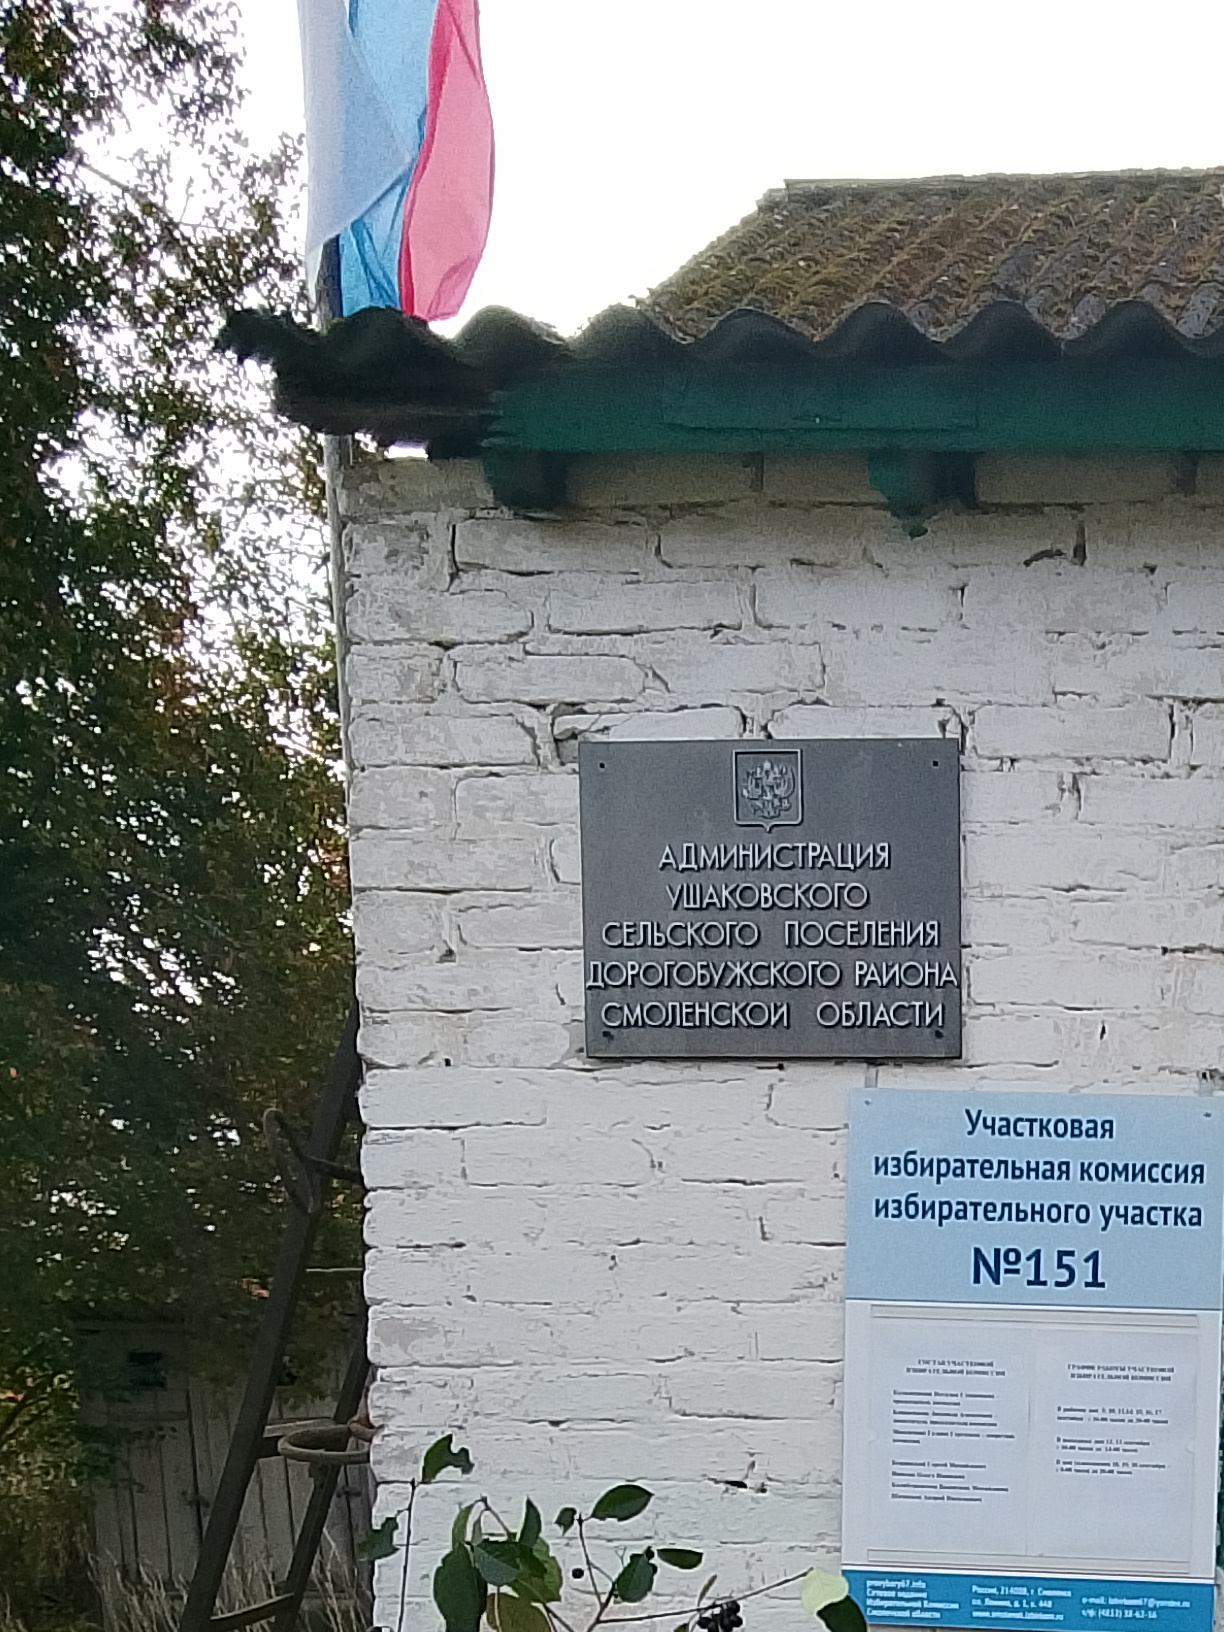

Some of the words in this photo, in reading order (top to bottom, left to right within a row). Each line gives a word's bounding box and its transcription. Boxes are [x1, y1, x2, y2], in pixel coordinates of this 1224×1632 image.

[658, 842, 888, 870] АДМИНИСТРАЦИЯ
[666, 882, 869, 910] УШАКОВСКОГО
[601, 920, 760, 949] СЕЛЬСКОГО
[785, 920, 937, 946] ПОСЕЛЕНИЯ
[586, 961, 840, 988] ДОРОГОБУЖСКОГО
[856, 961, 957, 987] РАЙОНА
[601, 1001, 787, 1026] СМОЛЕНСКОЙ
[817, 1001, 942, 1026] ОБЛАСТИ
[965, 1109, 1113, 1138] Участковая
[875, 1150, 1070, 1184] избирательная
[1080, 1162, 1204, 1184] комиссия
[875, 1193, 1090, 1227] избирательного
[1100, 1205, 1201, 1231] участка
[973, 1247, 1105, 1288] №151
